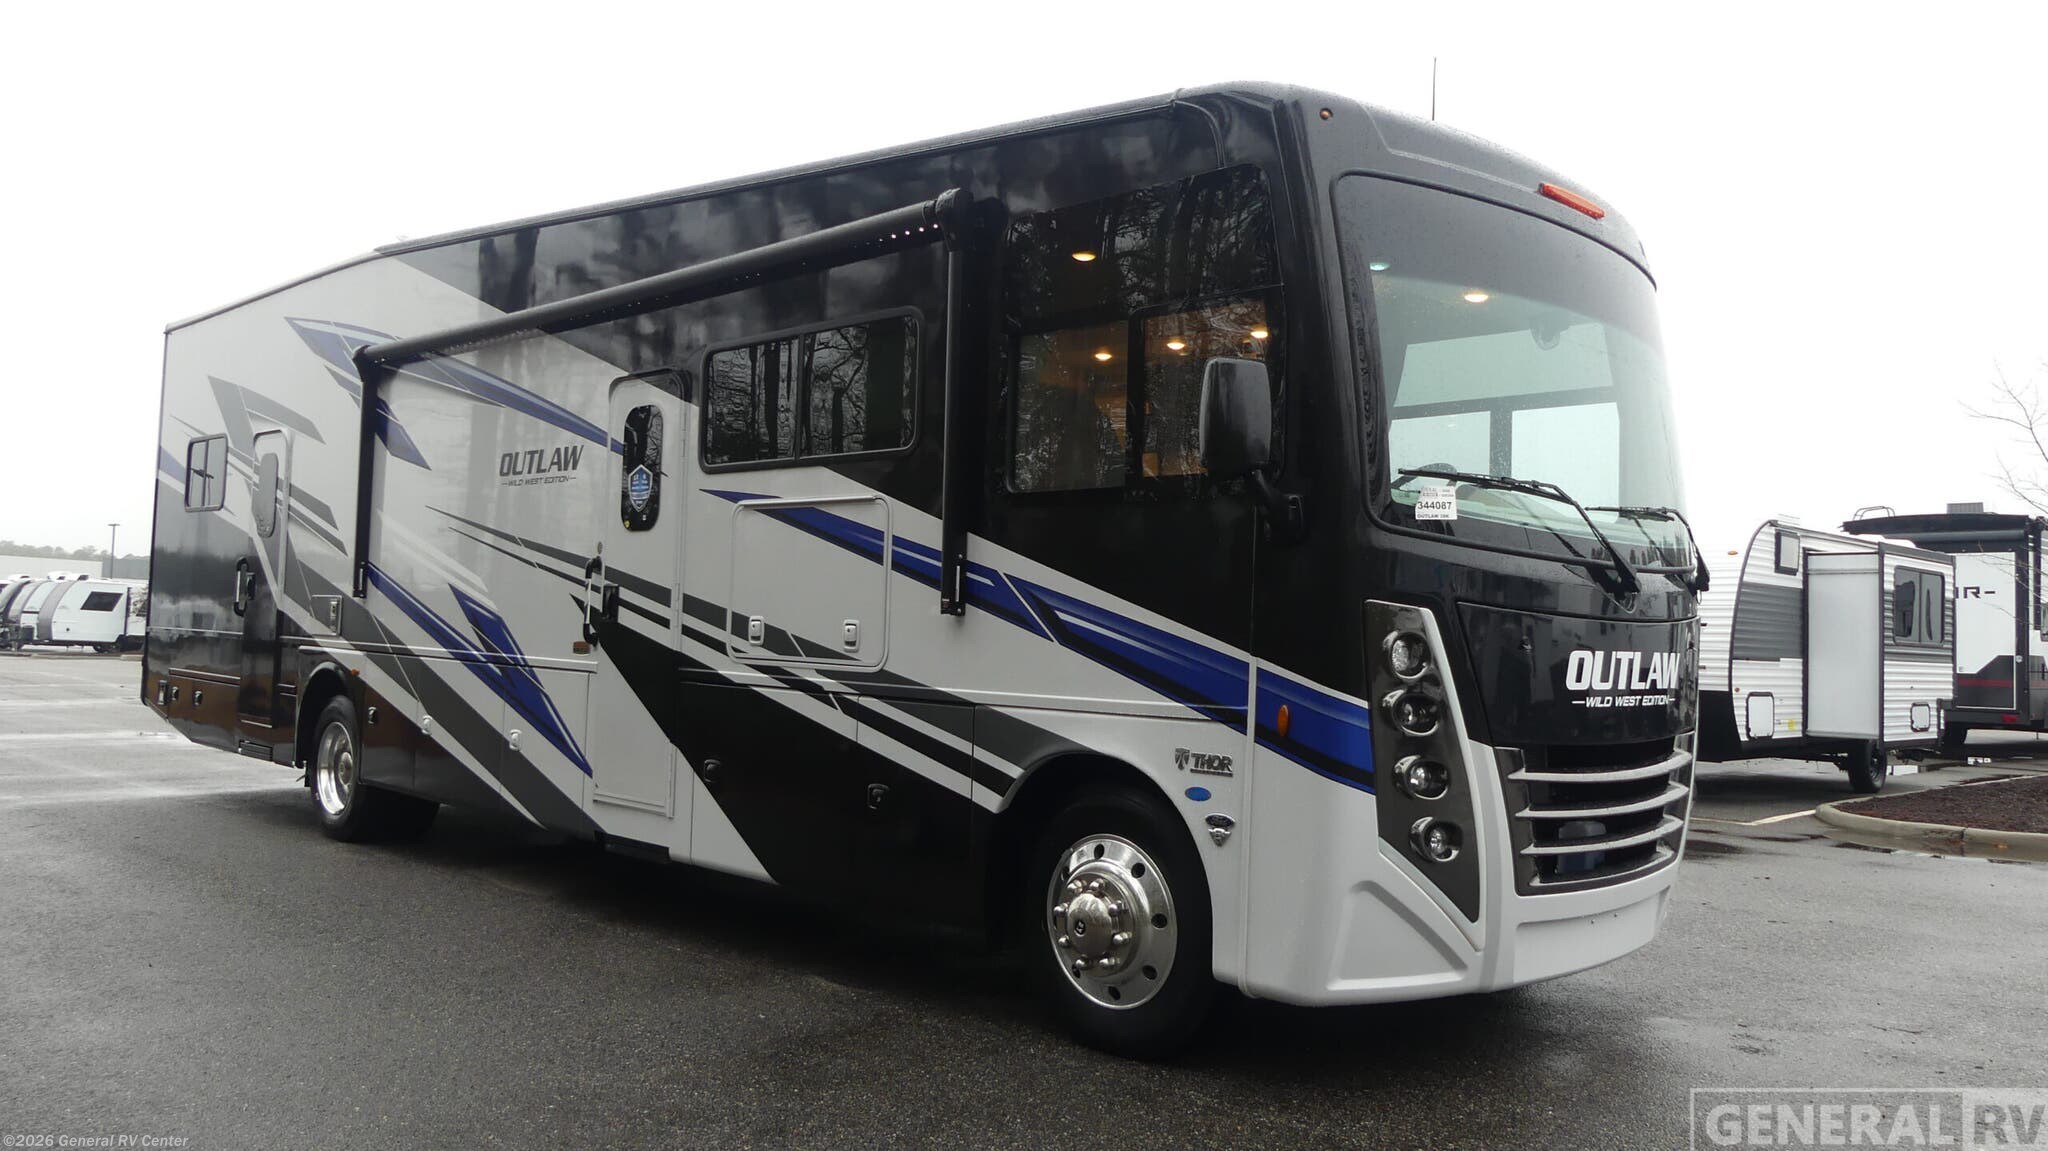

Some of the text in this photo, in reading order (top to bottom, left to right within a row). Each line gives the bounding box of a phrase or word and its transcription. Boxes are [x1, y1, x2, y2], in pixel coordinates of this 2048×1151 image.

[499, 445, 584, 477] OUTLAW
[508, 476, 569, 487] WILD WEST EDITION
[1417, 501, 1452, 510] 344087
[1566, 650, 1680, 690] OUTLAW
[1585, 695, 1669, 708] WILD WEST EDITION
[1191, 752, 1233, 772] THOR
